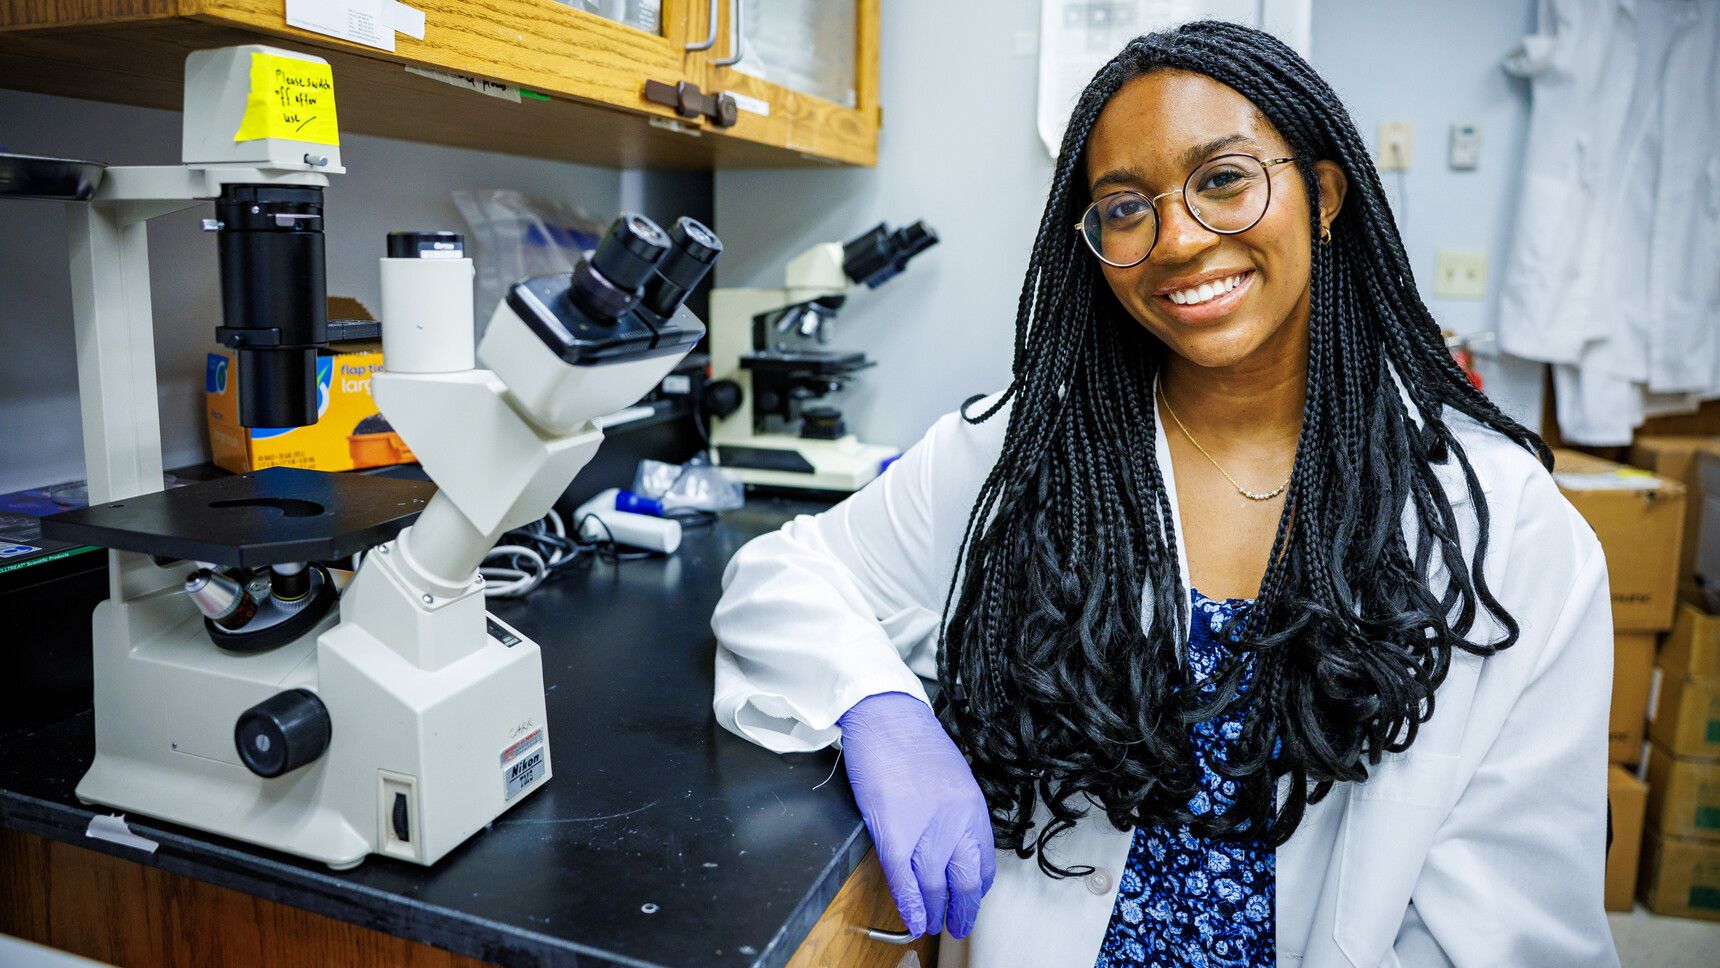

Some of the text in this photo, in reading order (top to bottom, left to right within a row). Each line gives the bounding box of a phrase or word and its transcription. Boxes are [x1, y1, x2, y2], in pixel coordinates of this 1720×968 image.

[276, 69, 305, 87] Please
[275, 86, 317, 107] off after
[284, 113, 300, 123] use
[341, 364, 366, 377] flap
[342, 377, 372, 396] larg
[511, 754, 539, 778] Nikon
